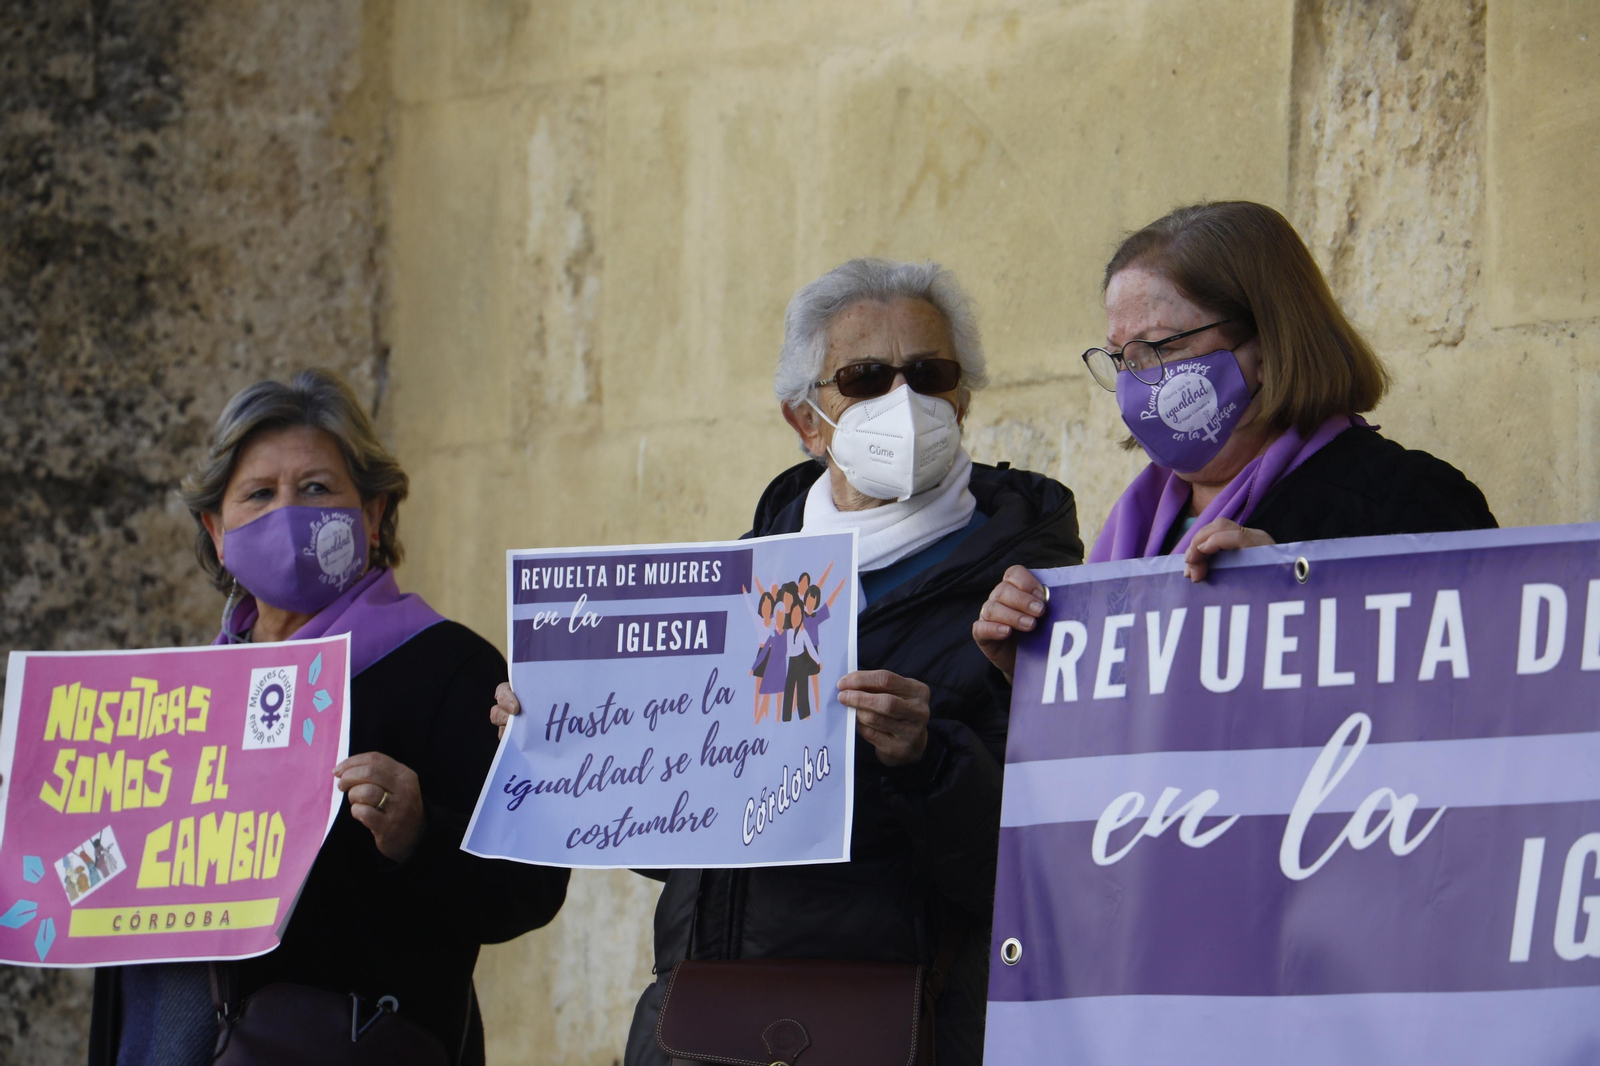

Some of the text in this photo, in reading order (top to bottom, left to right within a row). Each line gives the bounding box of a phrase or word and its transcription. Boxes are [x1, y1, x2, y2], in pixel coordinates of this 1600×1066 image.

[1164, 367, 1175, 381] de
[1176, 361, 1211, 377] mujeres
[1165, 379, 1208, 424] igualdad
[1188, 425, 1200, 441] la
[1202, 402, 1237, 432] Iglesia
[521, 560, 722, 591] REVUELTA DE MUJERES
[532, 593, 604, 633] en la
[617, 619, 708, 653] IGLESIA
[1041, 589, 1470, 704] REVUELTA
[43, 676, 211, 744] NOSOTRAS
[248, 669, 293, 744] Mujeres Cristianas en la Iglesia
[545, 667, 736, 743] Hasta que la
[38, 745, 229, 814] SOMOS EL
[503, 720, 769, 811] igualdad se haga
[741, 745, 831, 846] Córdoba
[1091, 712, 1447, 880] en la
[136, 810, 286, 889] CAMBIO
[566, 790, 719, 850] costumbre
[112, 909, 231, 931] CÓRDOBA
